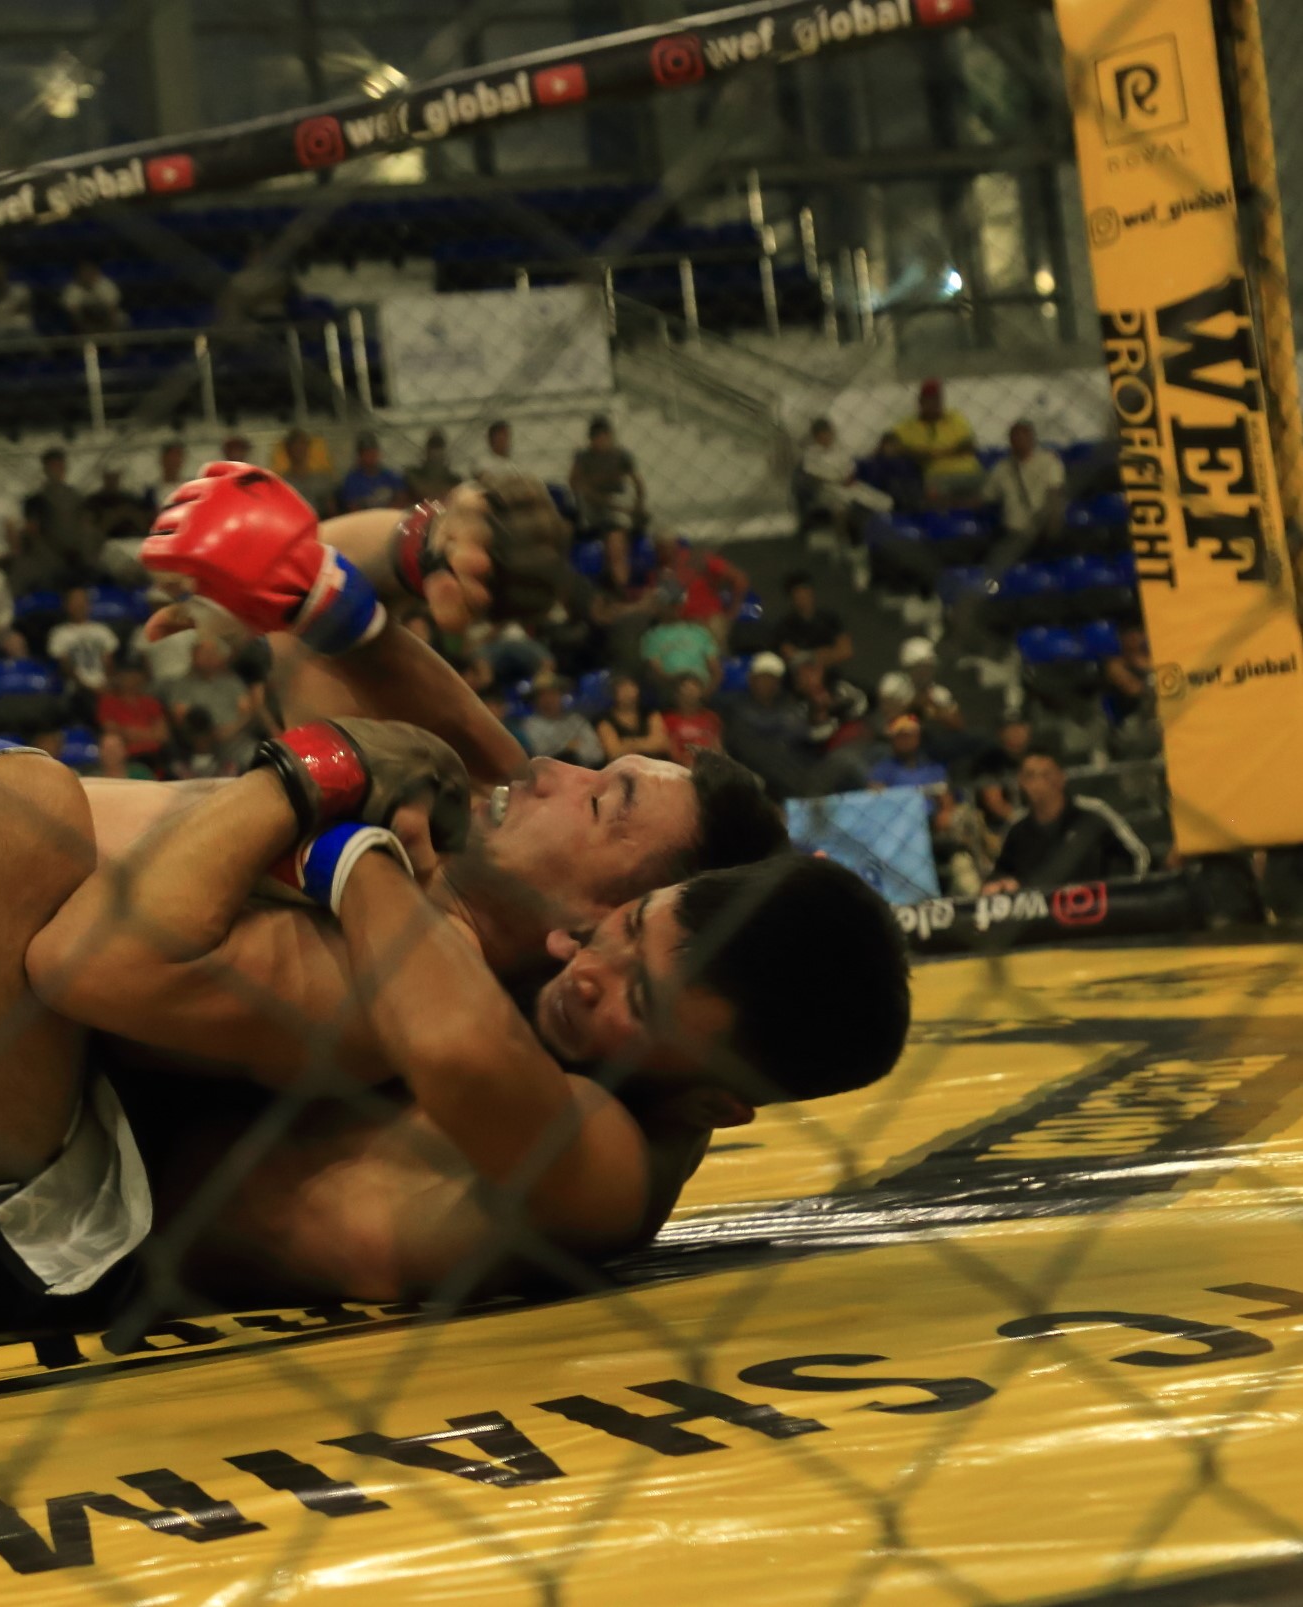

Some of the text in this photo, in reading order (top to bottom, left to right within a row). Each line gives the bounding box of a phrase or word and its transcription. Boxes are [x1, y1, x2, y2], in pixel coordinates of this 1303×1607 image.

[704, 0, 912, 69] wef_global
[344, 70, 532, 148] wef_global
[1156, 278, 1267, 583] WEF
